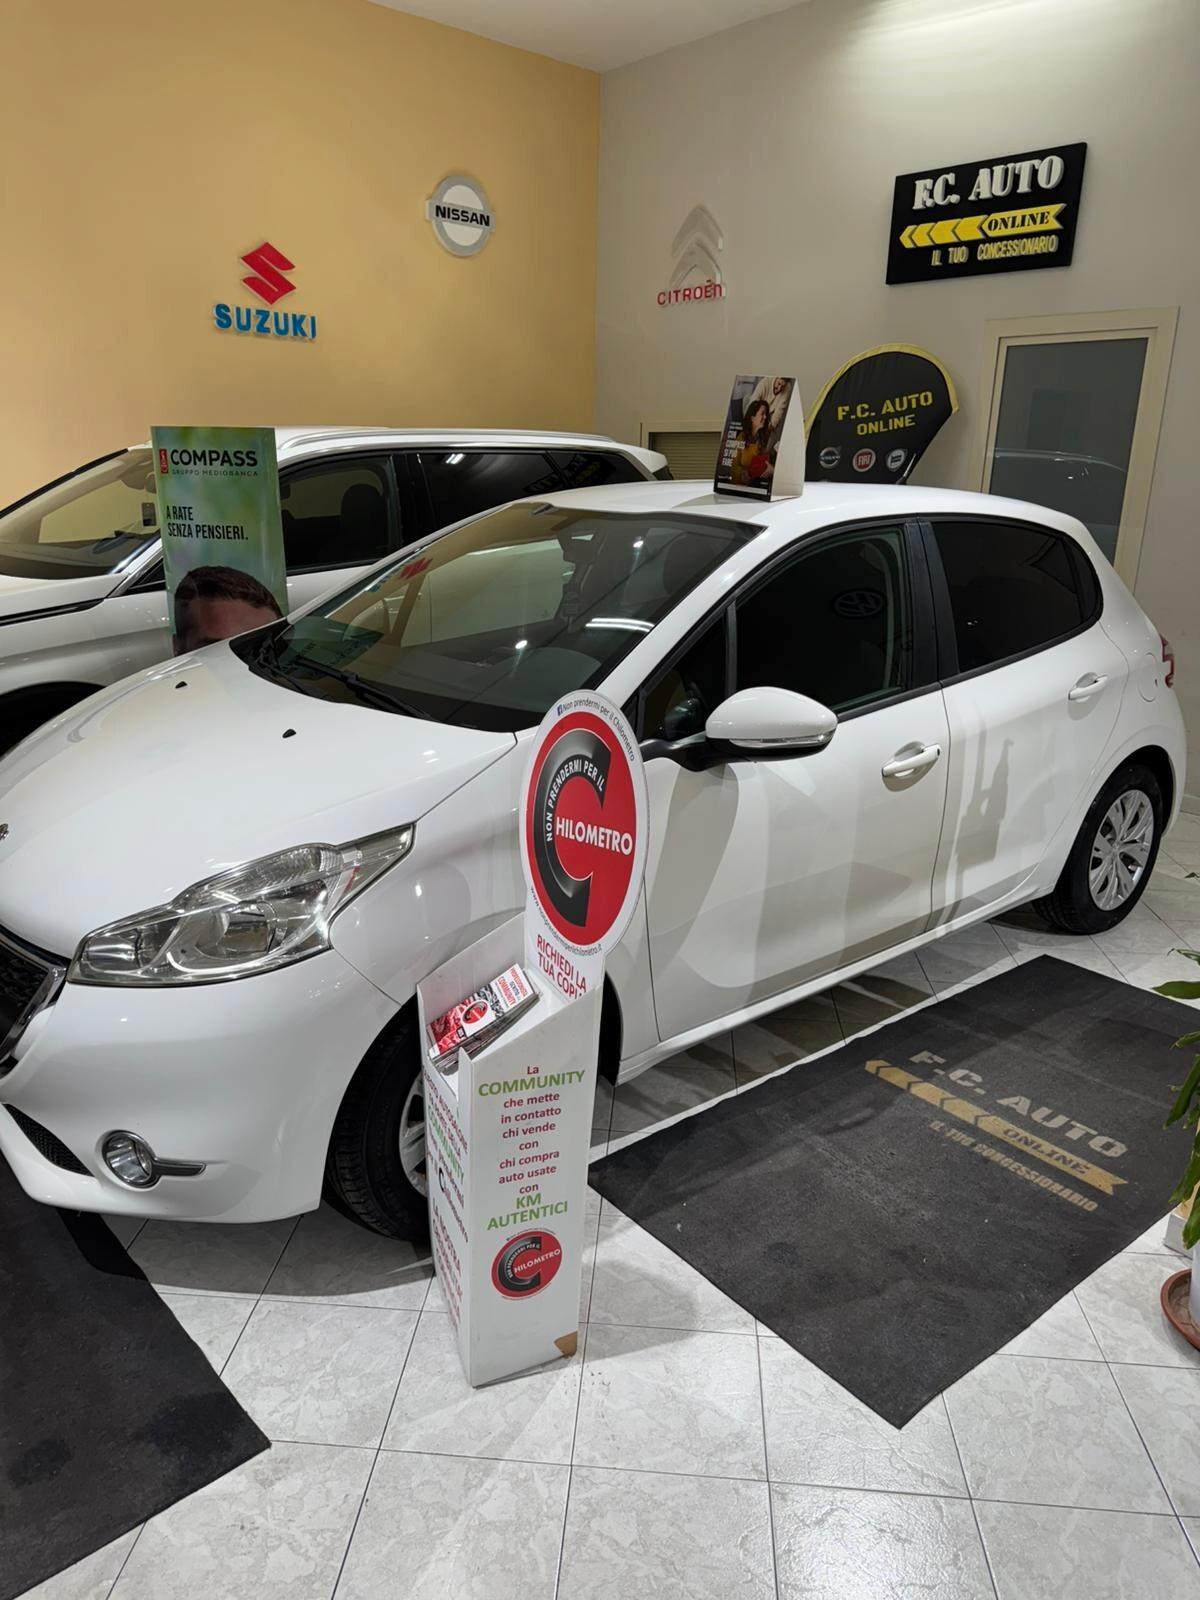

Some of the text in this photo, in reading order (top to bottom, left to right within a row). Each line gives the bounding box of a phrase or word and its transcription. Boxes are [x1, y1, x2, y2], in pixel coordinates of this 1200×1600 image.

[968, 155, 1065, 200] AUTO
[435, 204, 490, 227] NISSAN
[988, 211, 1050, 232] ONLINE
[931, 234, 1059, 266] IL TUO CONCESSIONARIO
[214, 303, 317, 340] SUZUKI
[837, 391, 933, 421] F.C. AUTO
[857, 414, 916, 436] ONLINE
[170, 449, 258, 467] COMPASS
[172, 468, 258, 477] GRUPPO MEDIOBANCA
[166, 505, 194, 521] A RATE
[167, 522, 249, 541] SENZA PENSIERI.
[600, 705, 610, 716] per
[548, 759, 582, 808] PRENDERMI
[583, 761, 598, 780] PER
[596, 775, 606, 791] IL
[536, 934, 586, 993] RICHIEDI LA
[537, 952, 582, 999] TUA COPI
[527, 1066, 539, 1075] La
[478, 1069, 585, 1097] COMMUNITY
[503, 1093, 560, 1109] che mette
[909, 1050, 1128, 1158] F.C. AUTO
[500, 1107, 561, 1124] in contatto
[502, 1122, 556, 1139] chi vende
[519, 1141, 539, 1150] con
[1002, 1128, 1090, 1176] ONLINE
[499, 1151, 560, 1169] chi compra
[947, 1128, 976, 1146] TUO
[974, 1143, 1098, 1212] CONCESSIONARIO
[498, 1165, 557, 1184] auto usate
[519, 1184, 539, 1194] con
[516, 1193, 541, 1209] KM
[487, 1201, 568, 1231] AUTENTICI
